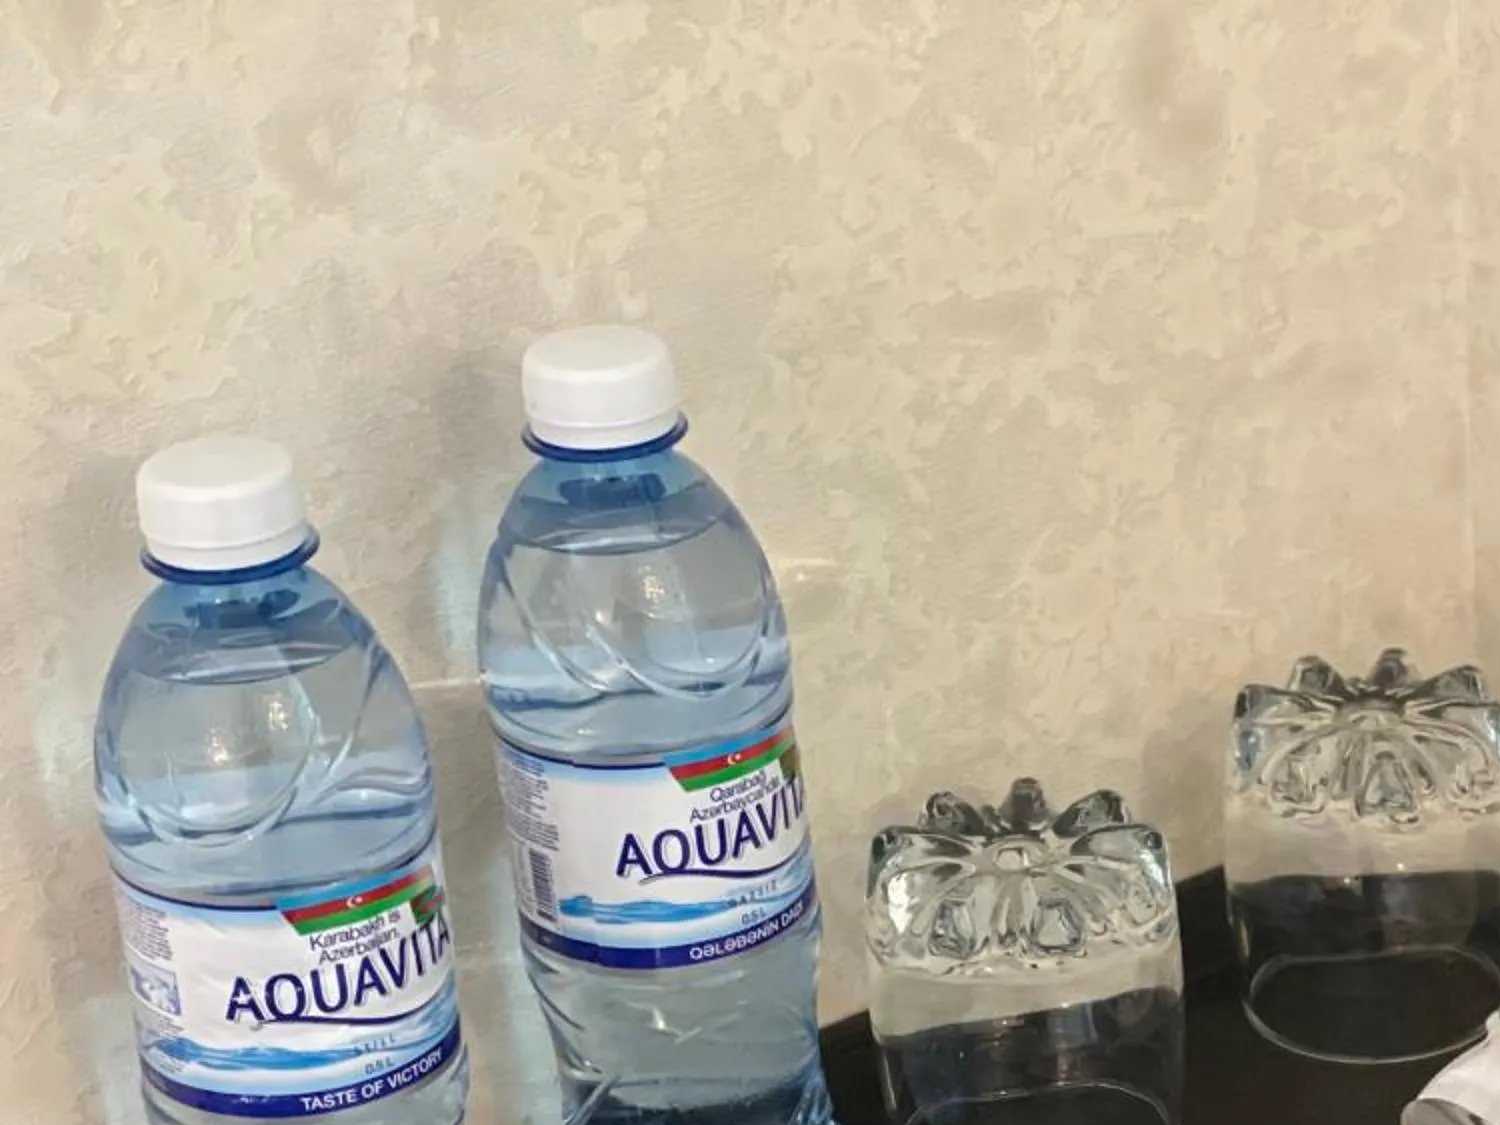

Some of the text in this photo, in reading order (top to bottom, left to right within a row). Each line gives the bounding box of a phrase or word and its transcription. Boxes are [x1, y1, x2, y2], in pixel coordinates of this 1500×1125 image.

[616, 778, 804, 880] AQUAVIT
[226, 910, 451, 1025] AQUAVITA
[309, 914, 386, 951] Karabakh
[302, 1047, 443, 1112] TASTE OF VICTORY
